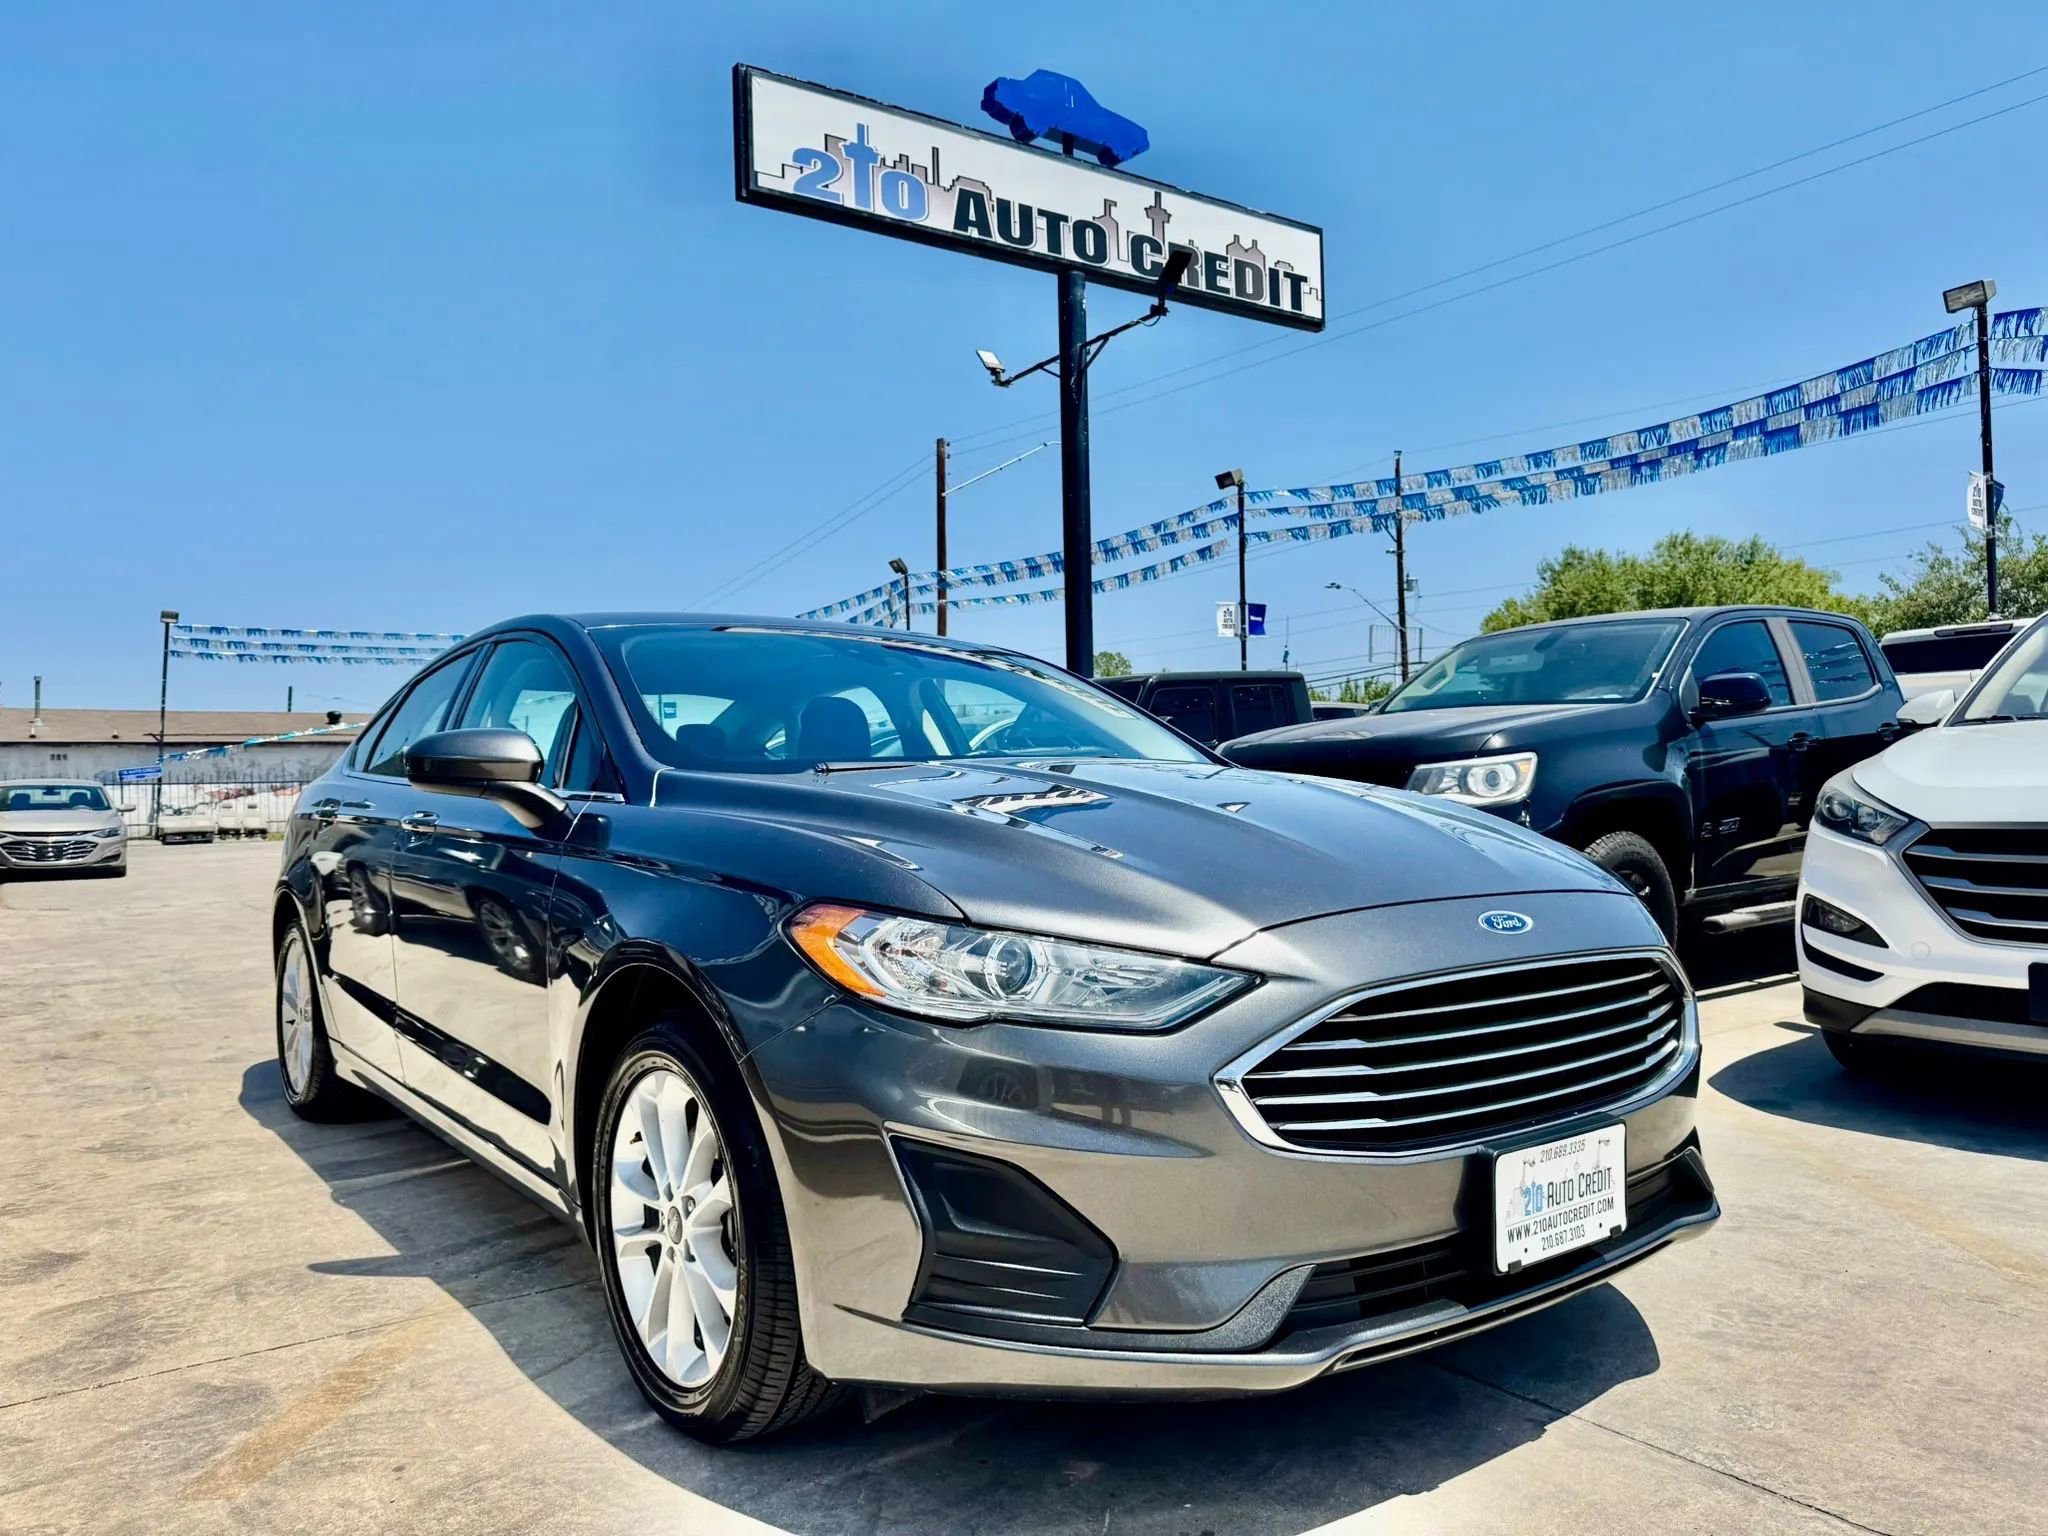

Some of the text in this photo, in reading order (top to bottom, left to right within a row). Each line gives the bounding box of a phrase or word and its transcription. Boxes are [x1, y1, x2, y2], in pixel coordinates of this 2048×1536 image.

[793, 123, 1307, 312] 210 AUTO CREDIT
[1491, 915, 1522, 929] Ford
[1523, 1167, 1612, 1216] 210 AUTO CREDIT
[1507, 1196, 1614, 1244] WWW.210AUTOCREDIT.COM
[1541, 1224, 1586, 1251] 210.687.3103
